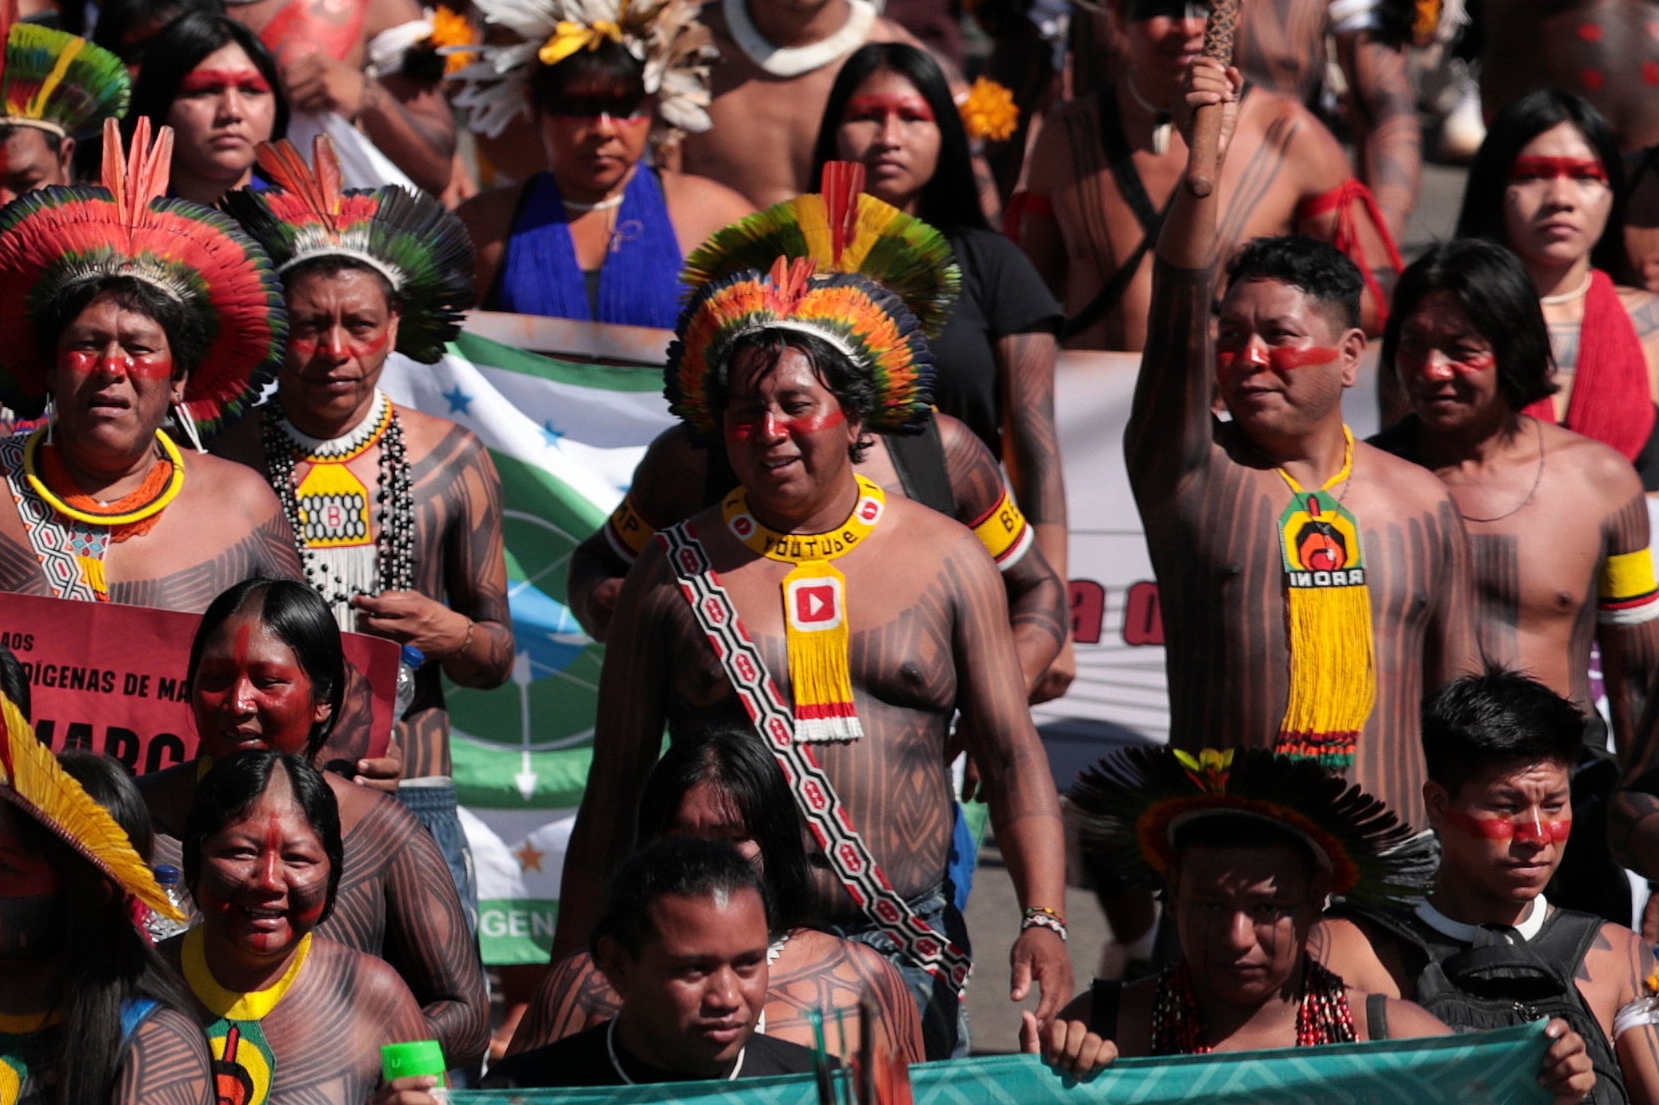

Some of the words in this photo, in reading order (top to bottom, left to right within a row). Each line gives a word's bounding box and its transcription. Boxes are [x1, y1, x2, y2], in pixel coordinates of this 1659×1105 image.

[0, 631, 35, 652] AOS
[123, 671, 151, 698] DE
[479, 909, 557, 937] GEN
